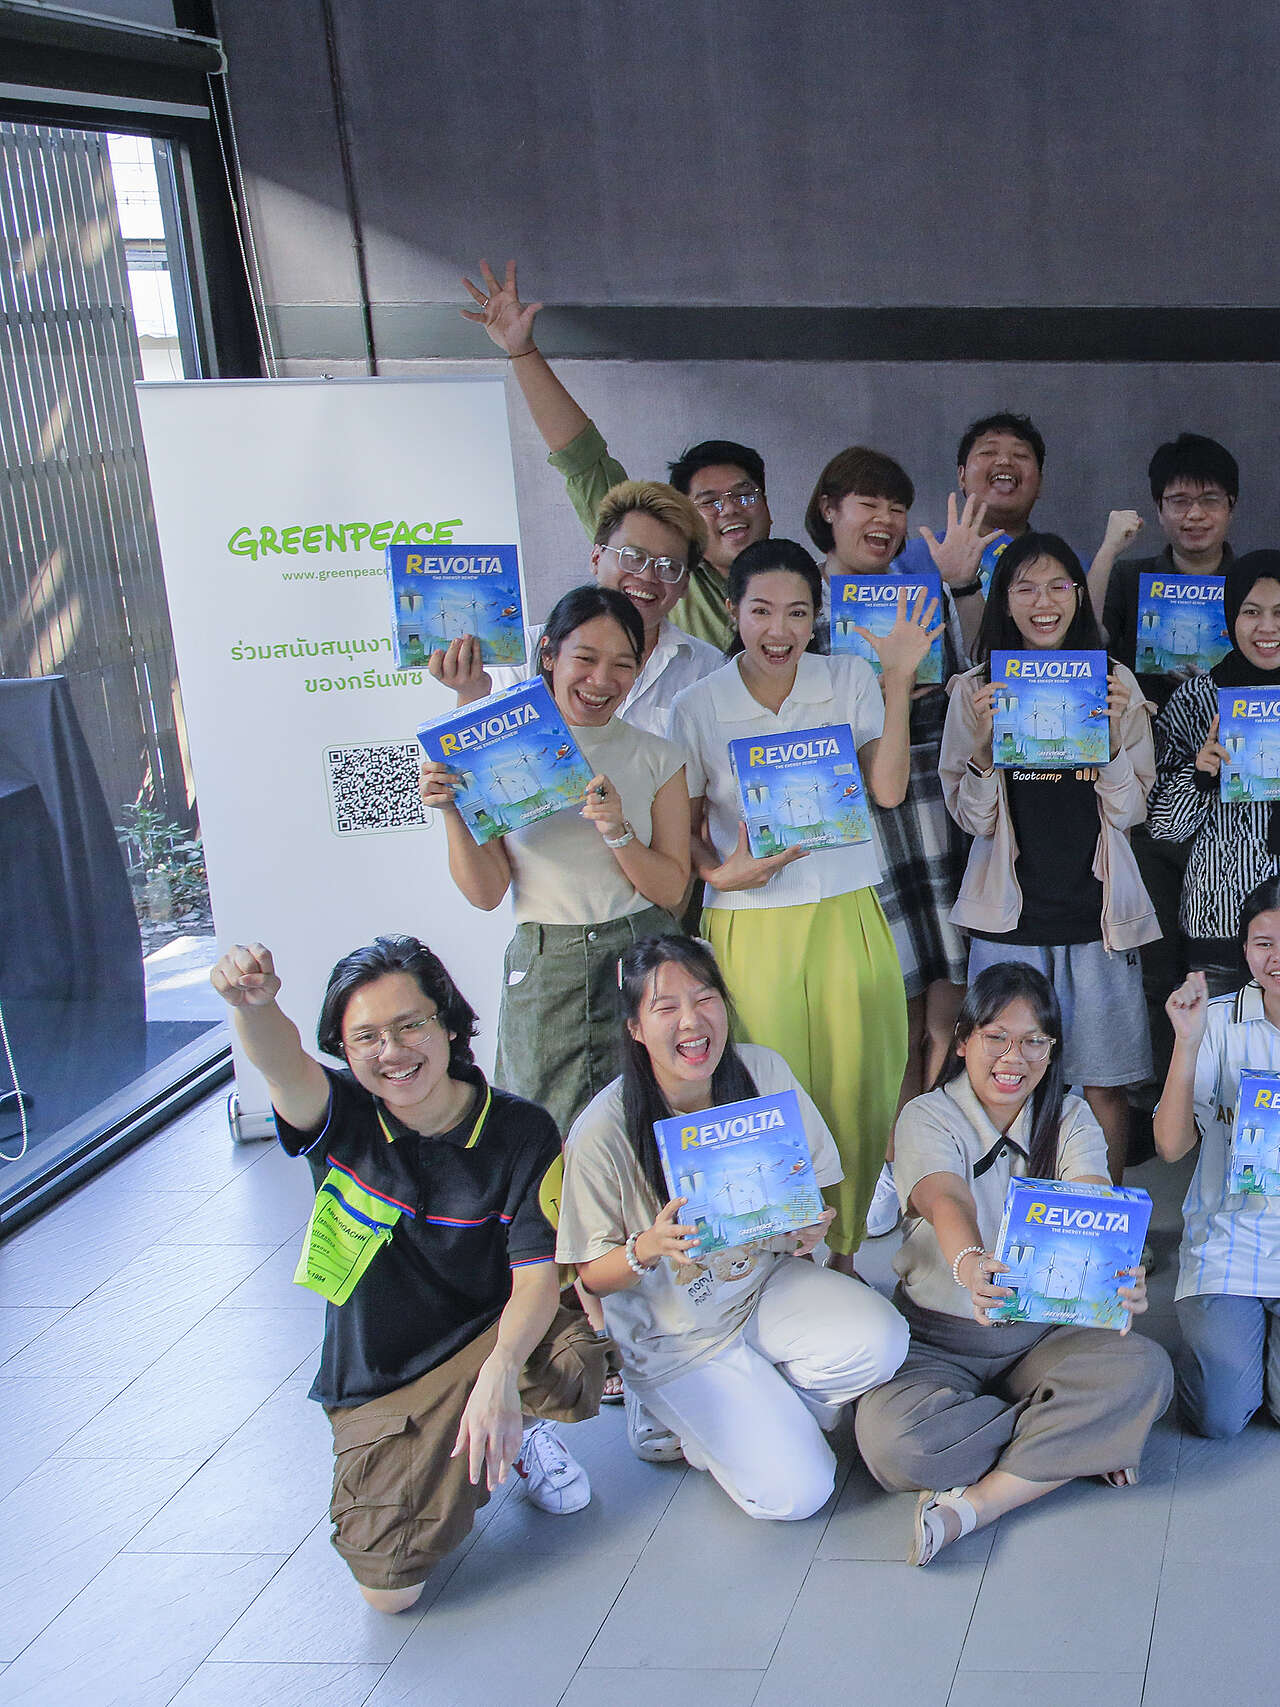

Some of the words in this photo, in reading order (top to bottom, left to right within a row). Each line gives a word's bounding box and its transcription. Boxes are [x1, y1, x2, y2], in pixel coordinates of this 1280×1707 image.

[228, 519, 463, 561] GREENPEACE
[405, 553, 503, 575] REVOLTA
[1150, 581, 1225, 600] REVOLTA
[1005, 659, 1092, 678] REVOLTA
[439, 703, 541, 757] REVOLTA
[750, 738, 840, 767] REVOLTA
[1012, 770, 1062, 783] Bootcamp
[680, 1108, 786, 1150] REVOLTA
[1025, 1202, 1129, 1234] REVOLTA
[688, 1270, 714, 1297] mom!
